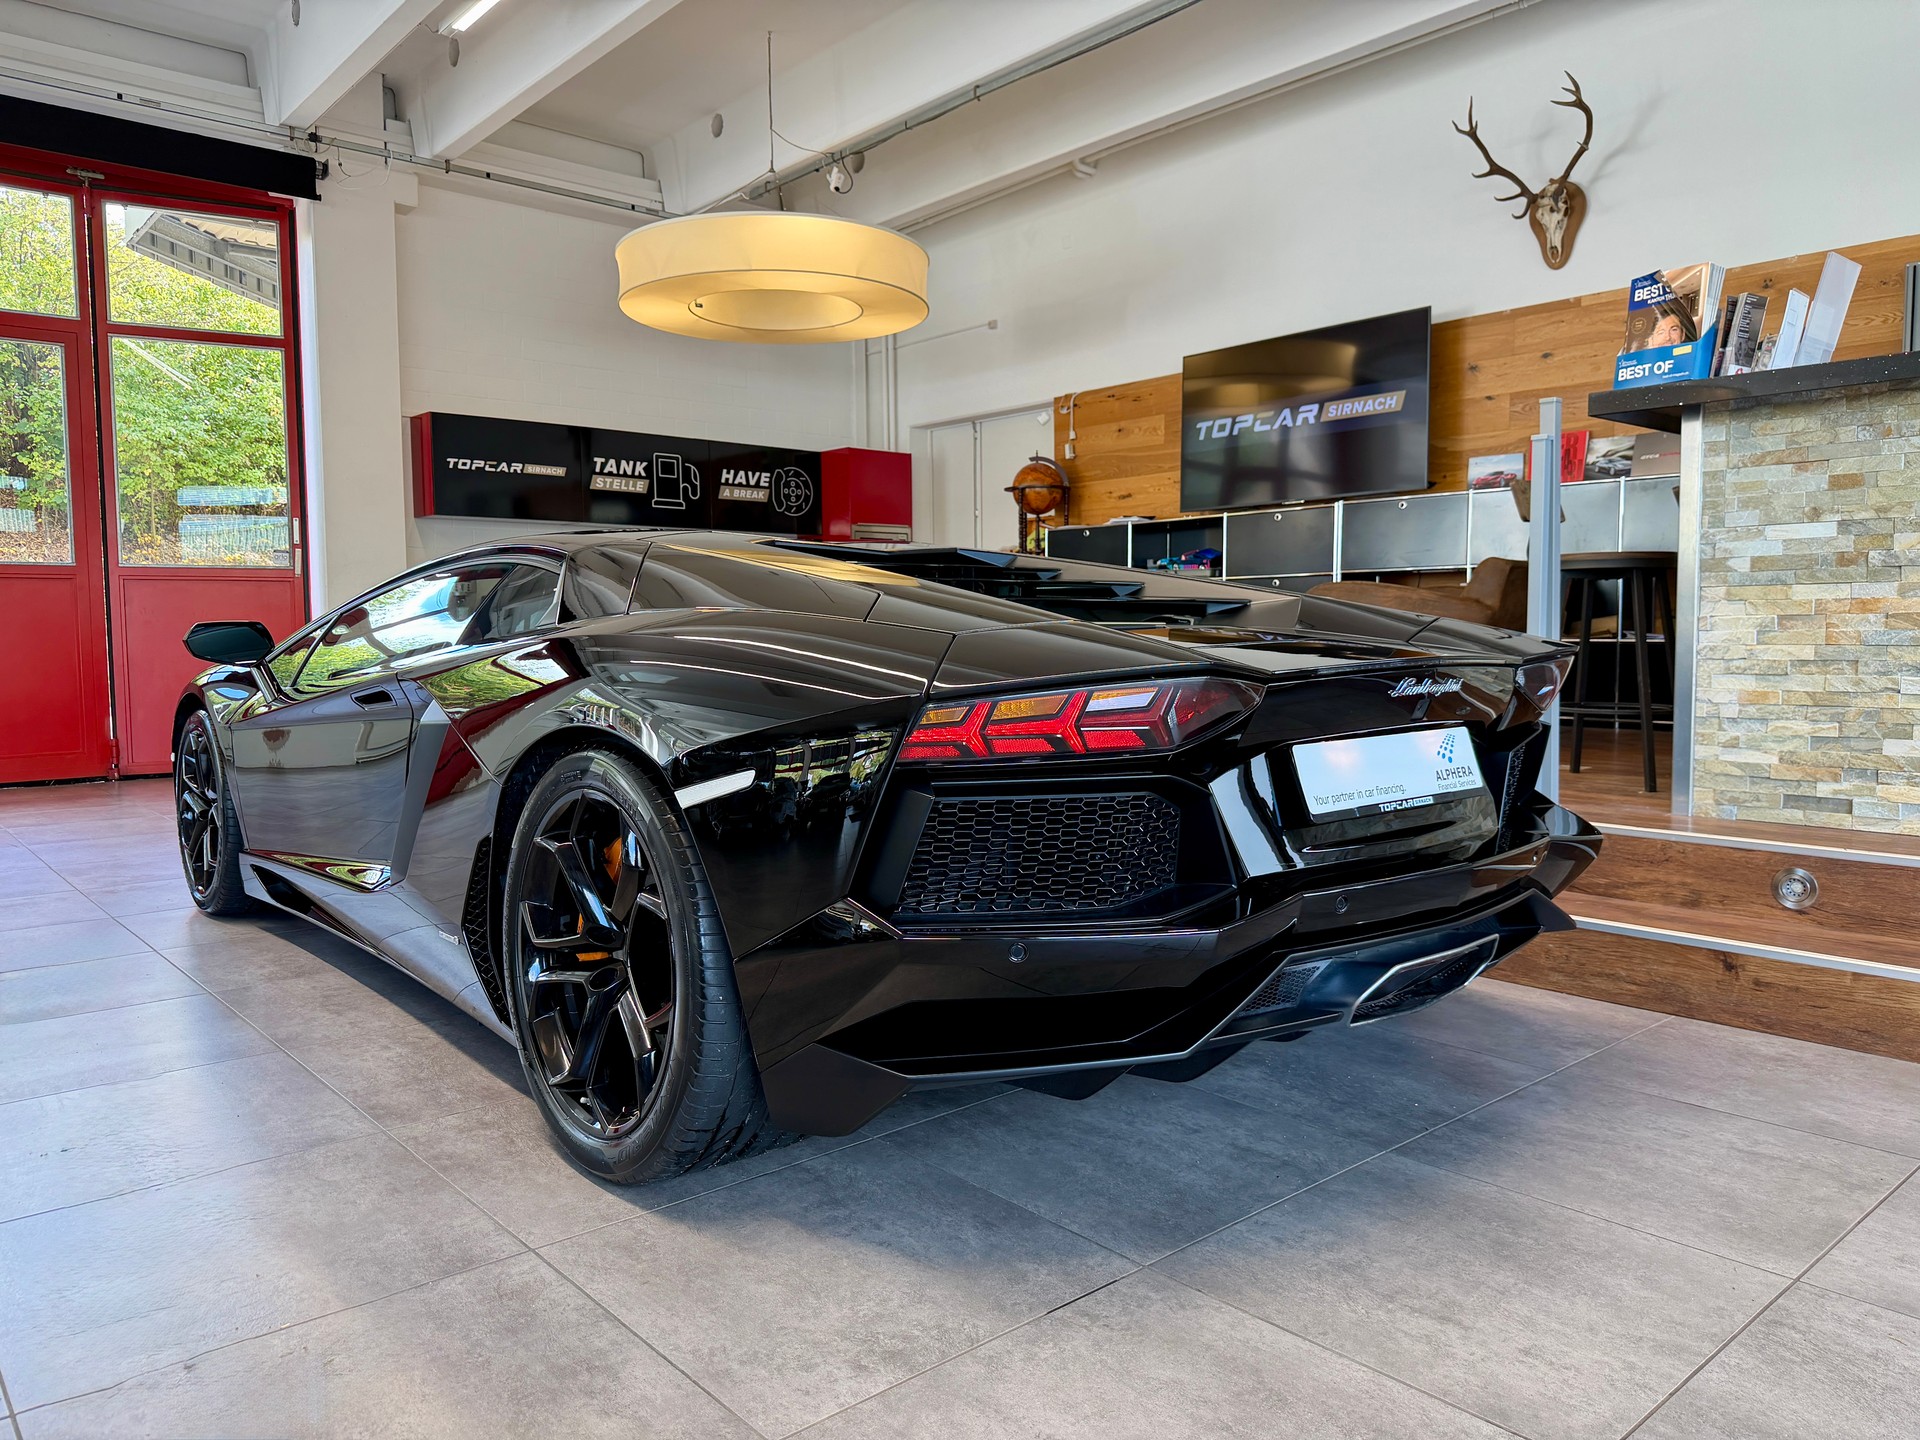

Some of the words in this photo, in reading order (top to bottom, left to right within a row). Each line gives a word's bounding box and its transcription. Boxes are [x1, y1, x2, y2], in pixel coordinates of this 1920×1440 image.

[1634, 283, 1664, 302] BEST
[1618, 363, 1652, 381] BEST
[1653, 360, 1674, 375] OF
[1196, 404, 1319, 440] TOPCAR
[1328, 395, 1397, 418] SIRNACH
[446, 458, 523, 473] TOPCAR
[527, 466, 563, 475] SIRNACH
[593, 457, 648, 477] TANK
[595, 477, 644, 491] STELLE
[720, 468, 771, 487] HAVE
[723, 489, 731, 497] A
[733, 489, 765, 499] BREAK
[1435, 765, 1474, 782] ALPHERA
[1437, 781, 1458, 791] Financial
[1458, 778, 1477, 788] Services
[1313, 794, 1331, 806] Your
[1331, 791, 1356, 805] partner
[1356, 789, 1363, 799] in
[1364, 789, 1375, 798] car
[1375, 783, 1407, 796] financing.
[1379, 799, 1414, 812] TOPCAR
